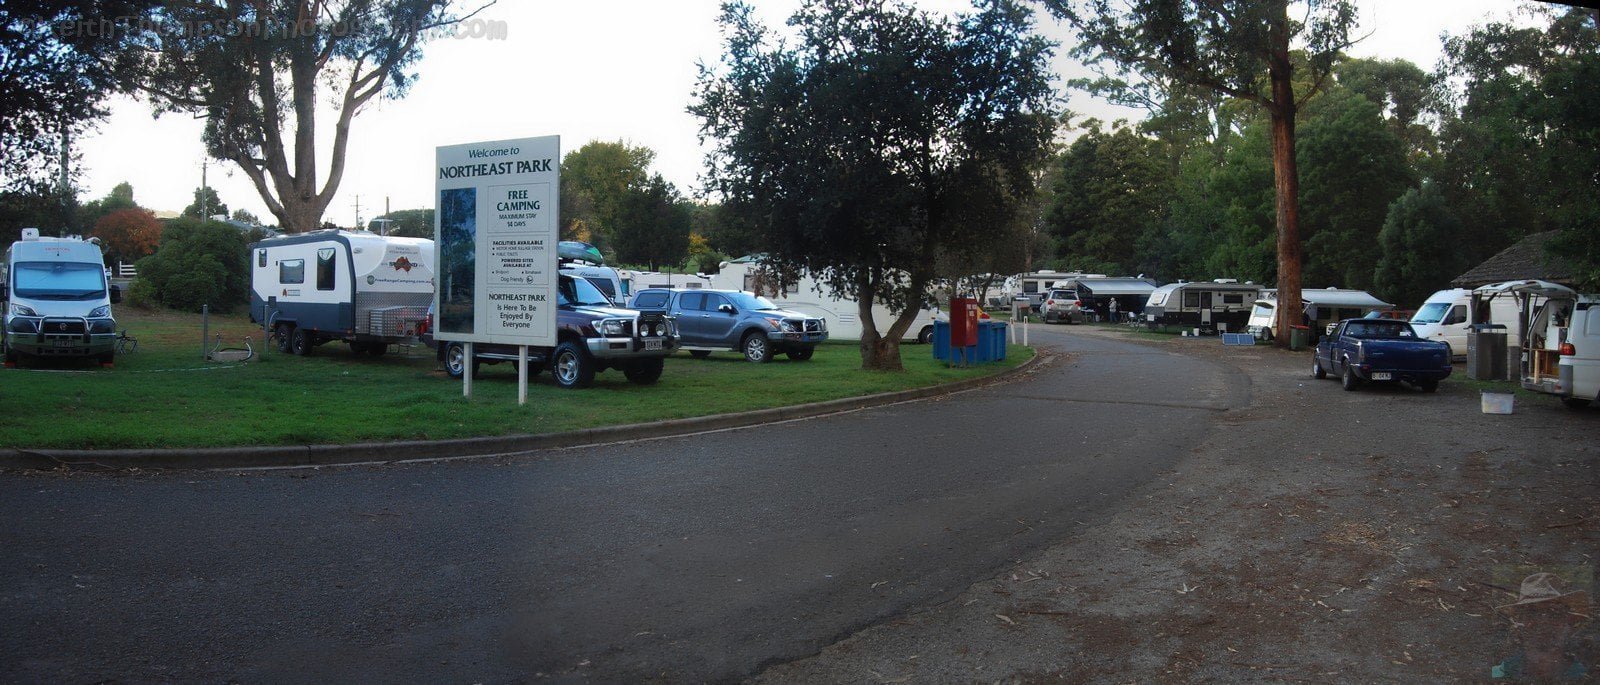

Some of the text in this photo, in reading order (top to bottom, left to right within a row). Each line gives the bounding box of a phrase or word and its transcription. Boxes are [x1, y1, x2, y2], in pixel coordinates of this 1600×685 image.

[468, 147, 520, 158] Welcome to
[440, 159, 552, 179] NORTHEAST PARK
[508, 190, 528, 200] FREE
[496, 200, 541, 211] CAMPING
[500, 312, 533, 321] Enjoyed By
[502, 320, 530, 329] Everyone
